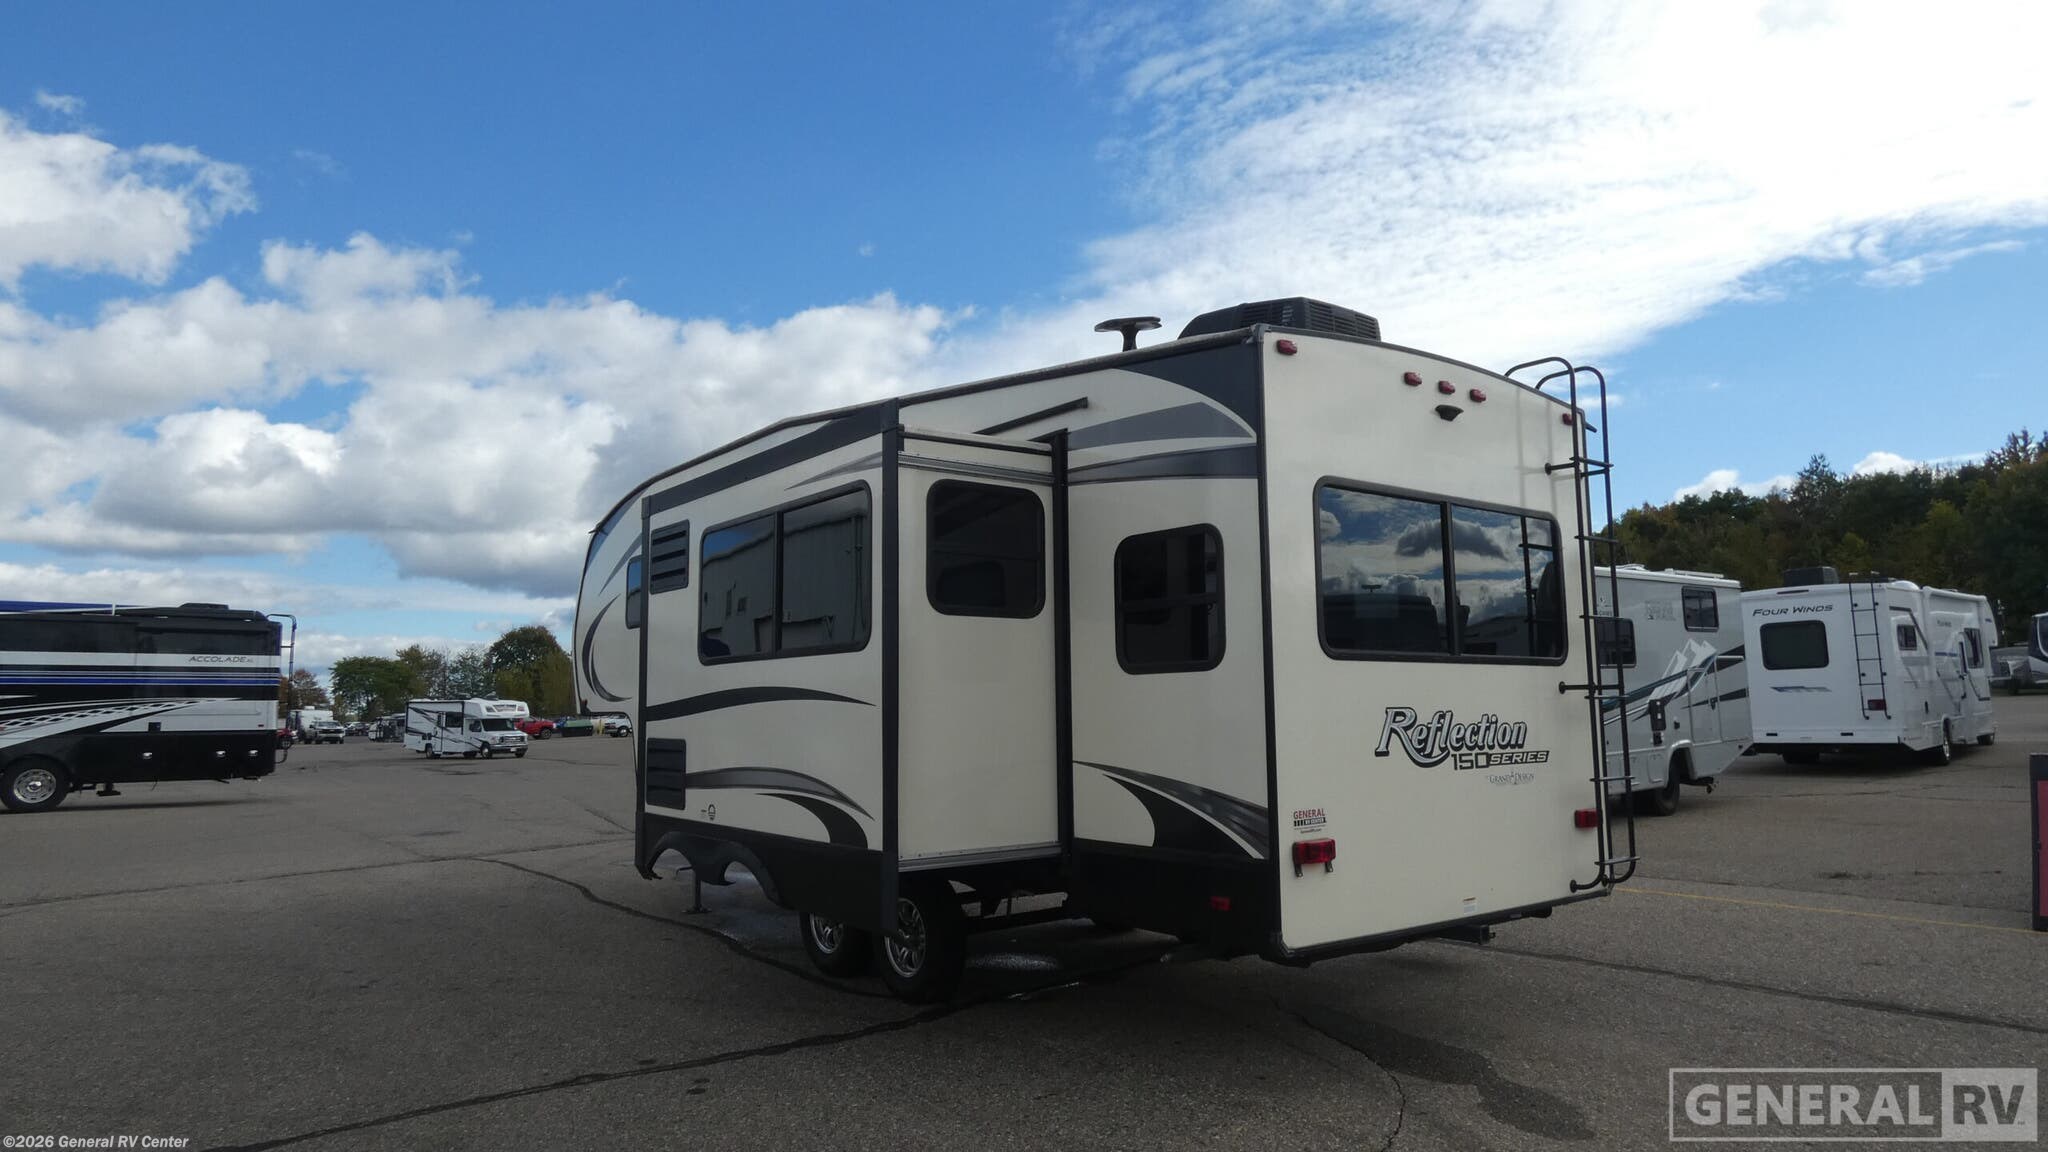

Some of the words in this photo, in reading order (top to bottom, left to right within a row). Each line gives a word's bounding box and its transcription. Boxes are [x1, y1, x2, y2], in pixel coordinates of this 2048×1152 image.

[1752, 608, 1789, 616] FOUR
[1792, 604, 1833, 614] WINDS
[188, 655, 246, 663] ACCOLADE
[1375, 706, 1528, 768] Reflection
[1451, 752, 1490, 771] 150
[1489, 751, 1549, 766] SERIES
[1293, 808, 1326, 820] GENERAL
